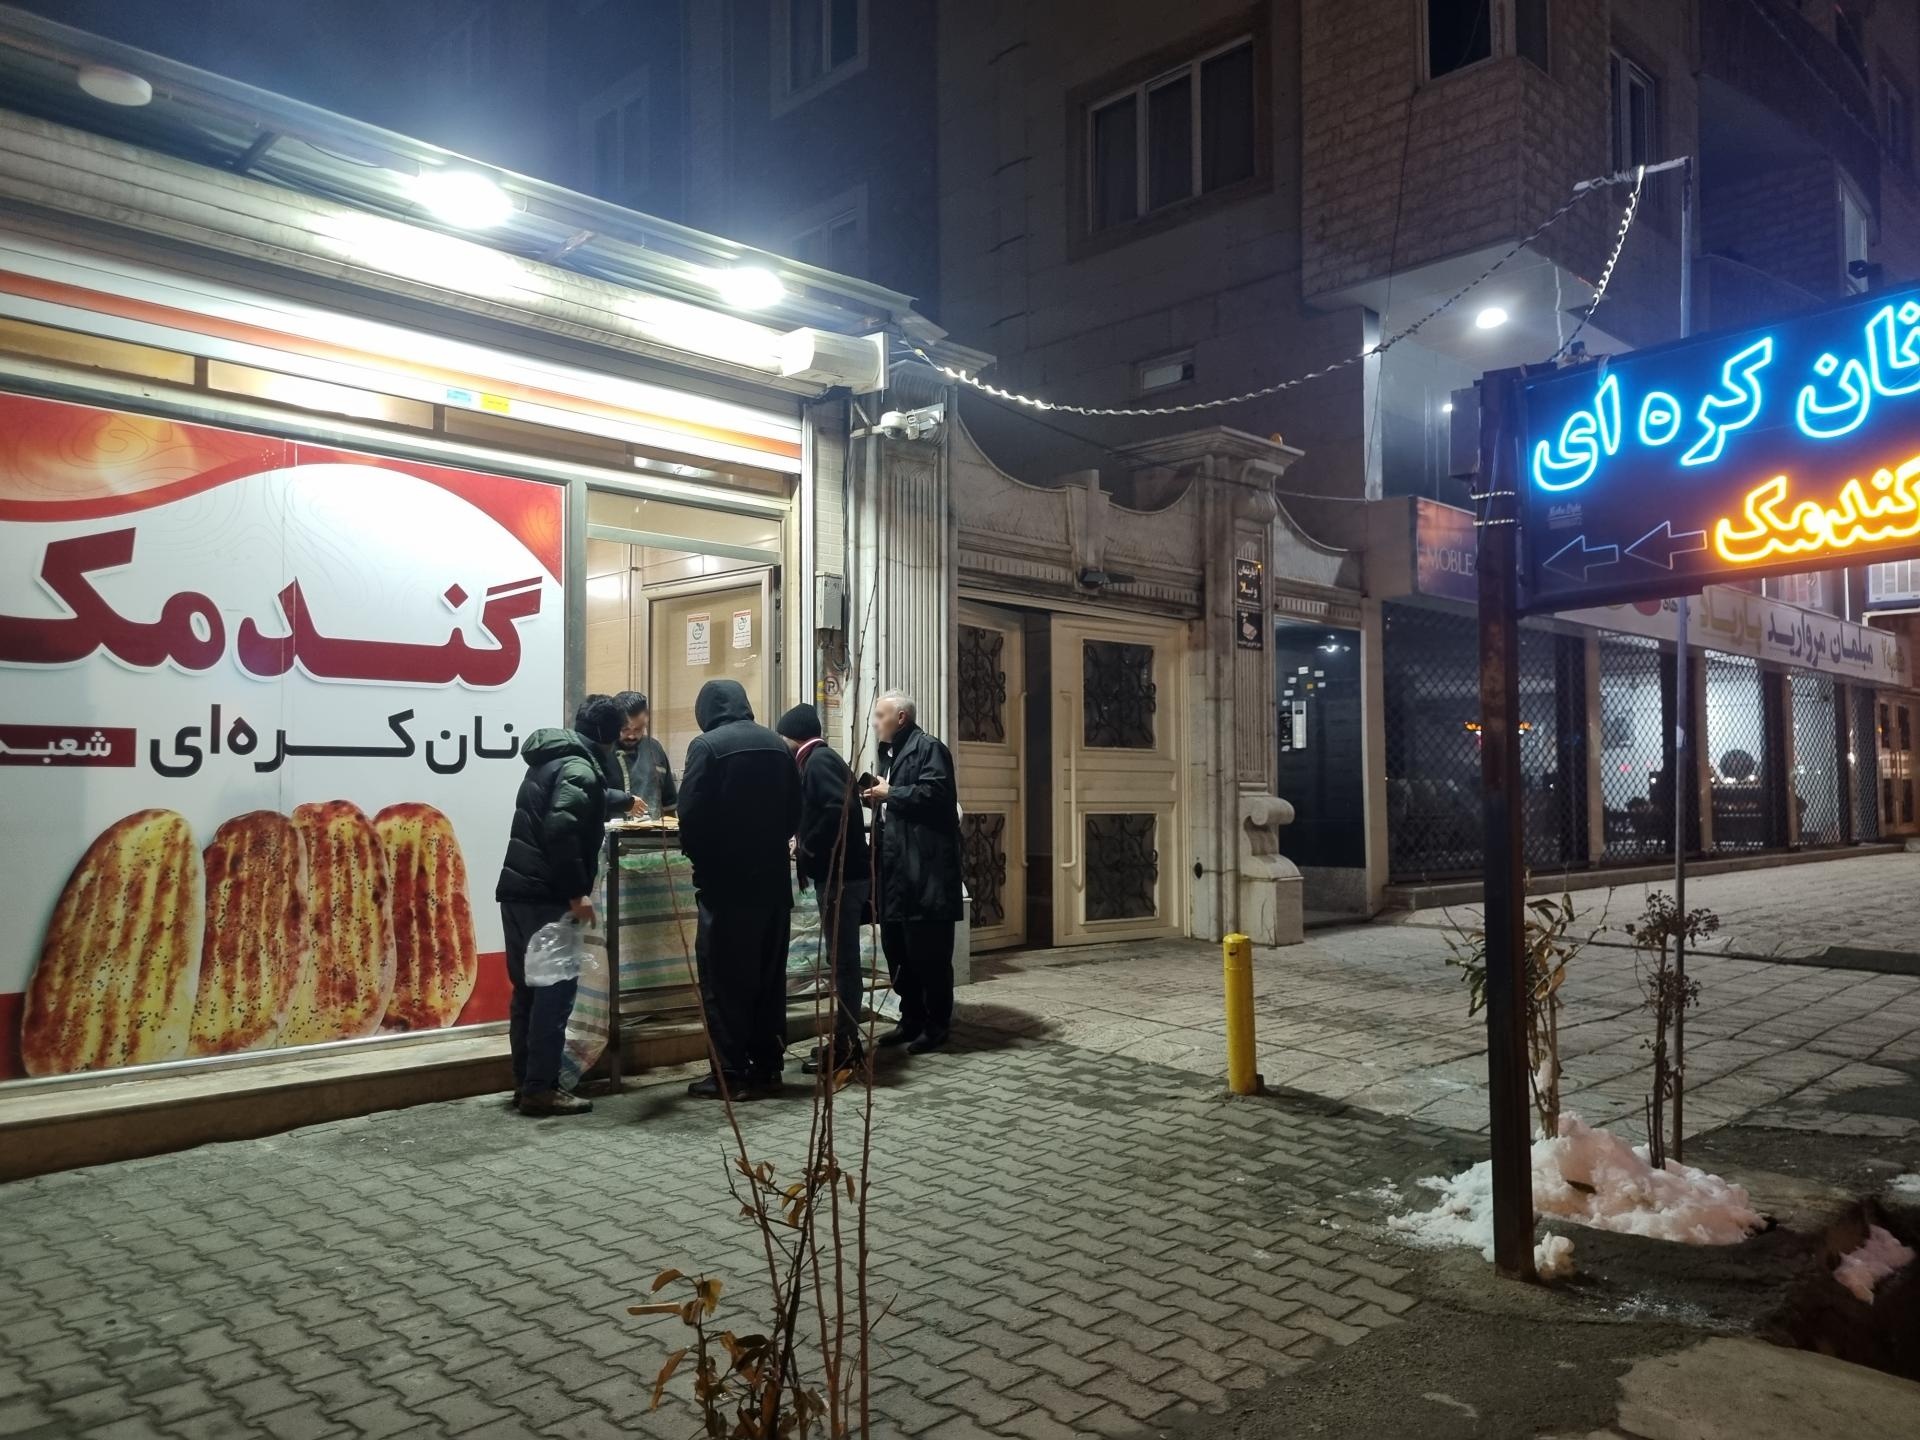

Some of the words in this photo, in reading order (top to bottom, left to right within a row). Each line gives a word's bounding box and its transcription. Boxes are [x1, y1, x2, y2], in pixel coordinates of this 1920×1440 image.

[0, 527, 543, 687] گندمک
[1767, 610, 1826, 667] مروارید
[1830, 621, 1874, 671] مبلمان
[0, 731, 112, 764] شعب
[426, 715, 519, 775] نان
